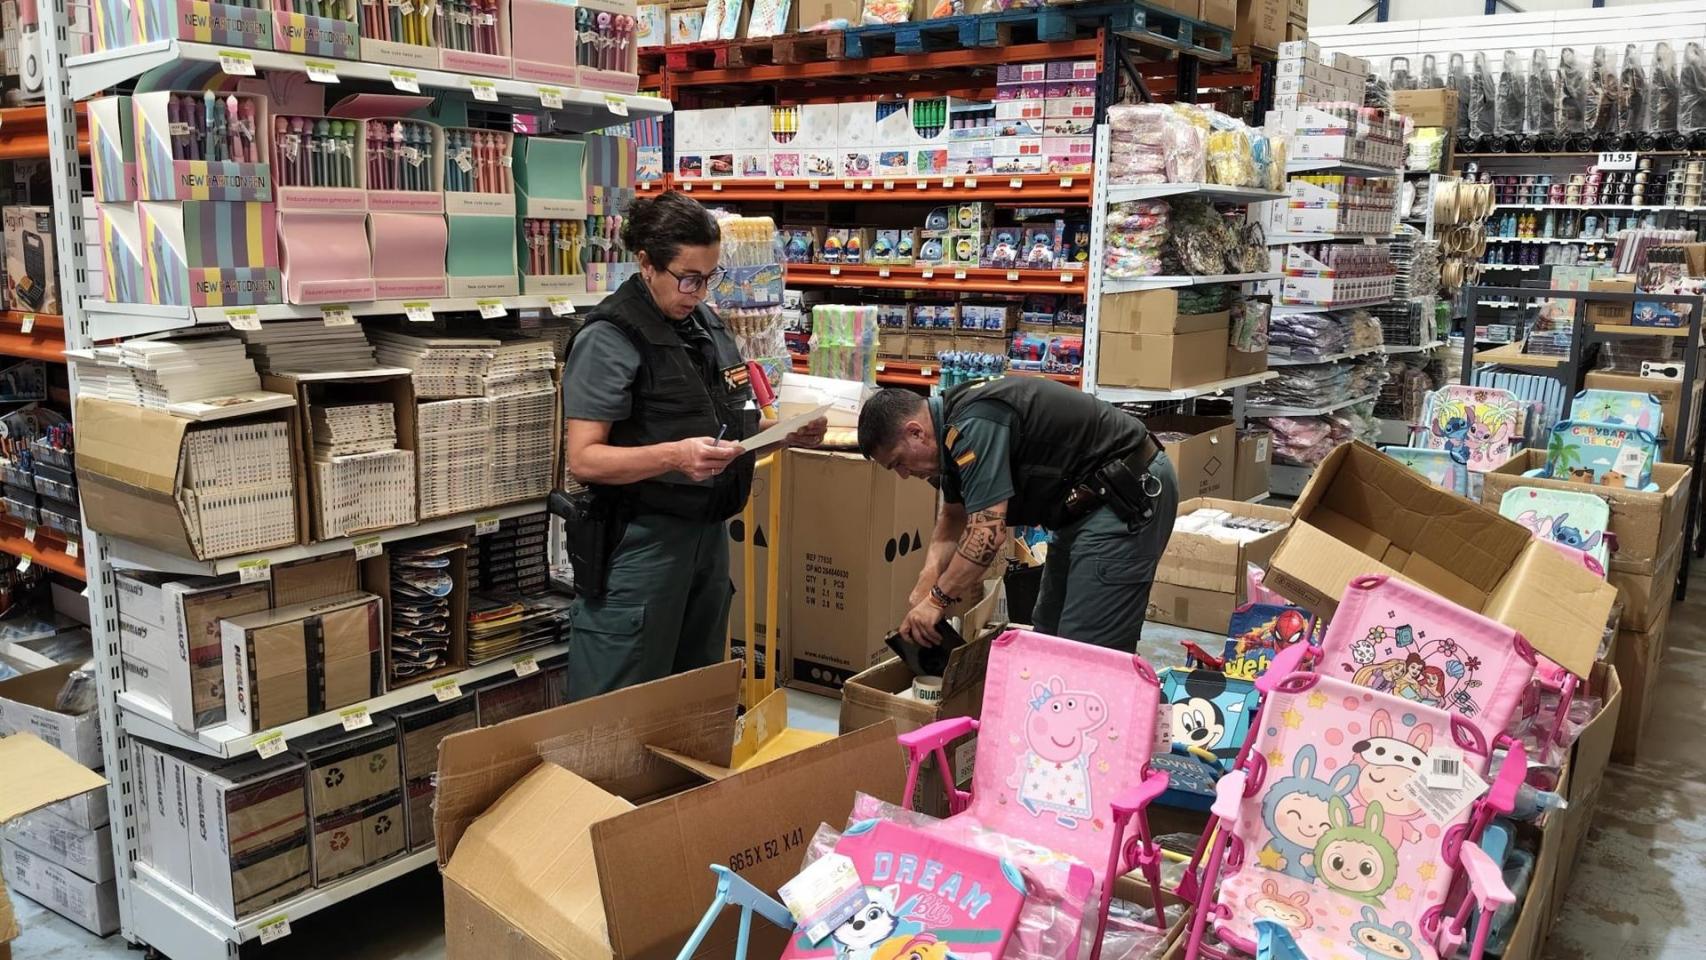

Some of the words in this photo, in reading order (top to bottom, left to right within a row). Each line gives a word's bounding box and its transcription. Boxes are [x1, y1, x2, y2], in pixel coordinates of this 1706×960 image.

[1602, 153, 1632, 162] 11.95
[182, 174, 204, 187] NEW
[197, 281, 218, 293] NEW
[805, 575, 817, 584] QTY
[835, 591, 844, 600] KG
[835, 602, 844, 611] KG
[764, 839, 780, 859] 52
[873, 852, 991, 919] DREAM
